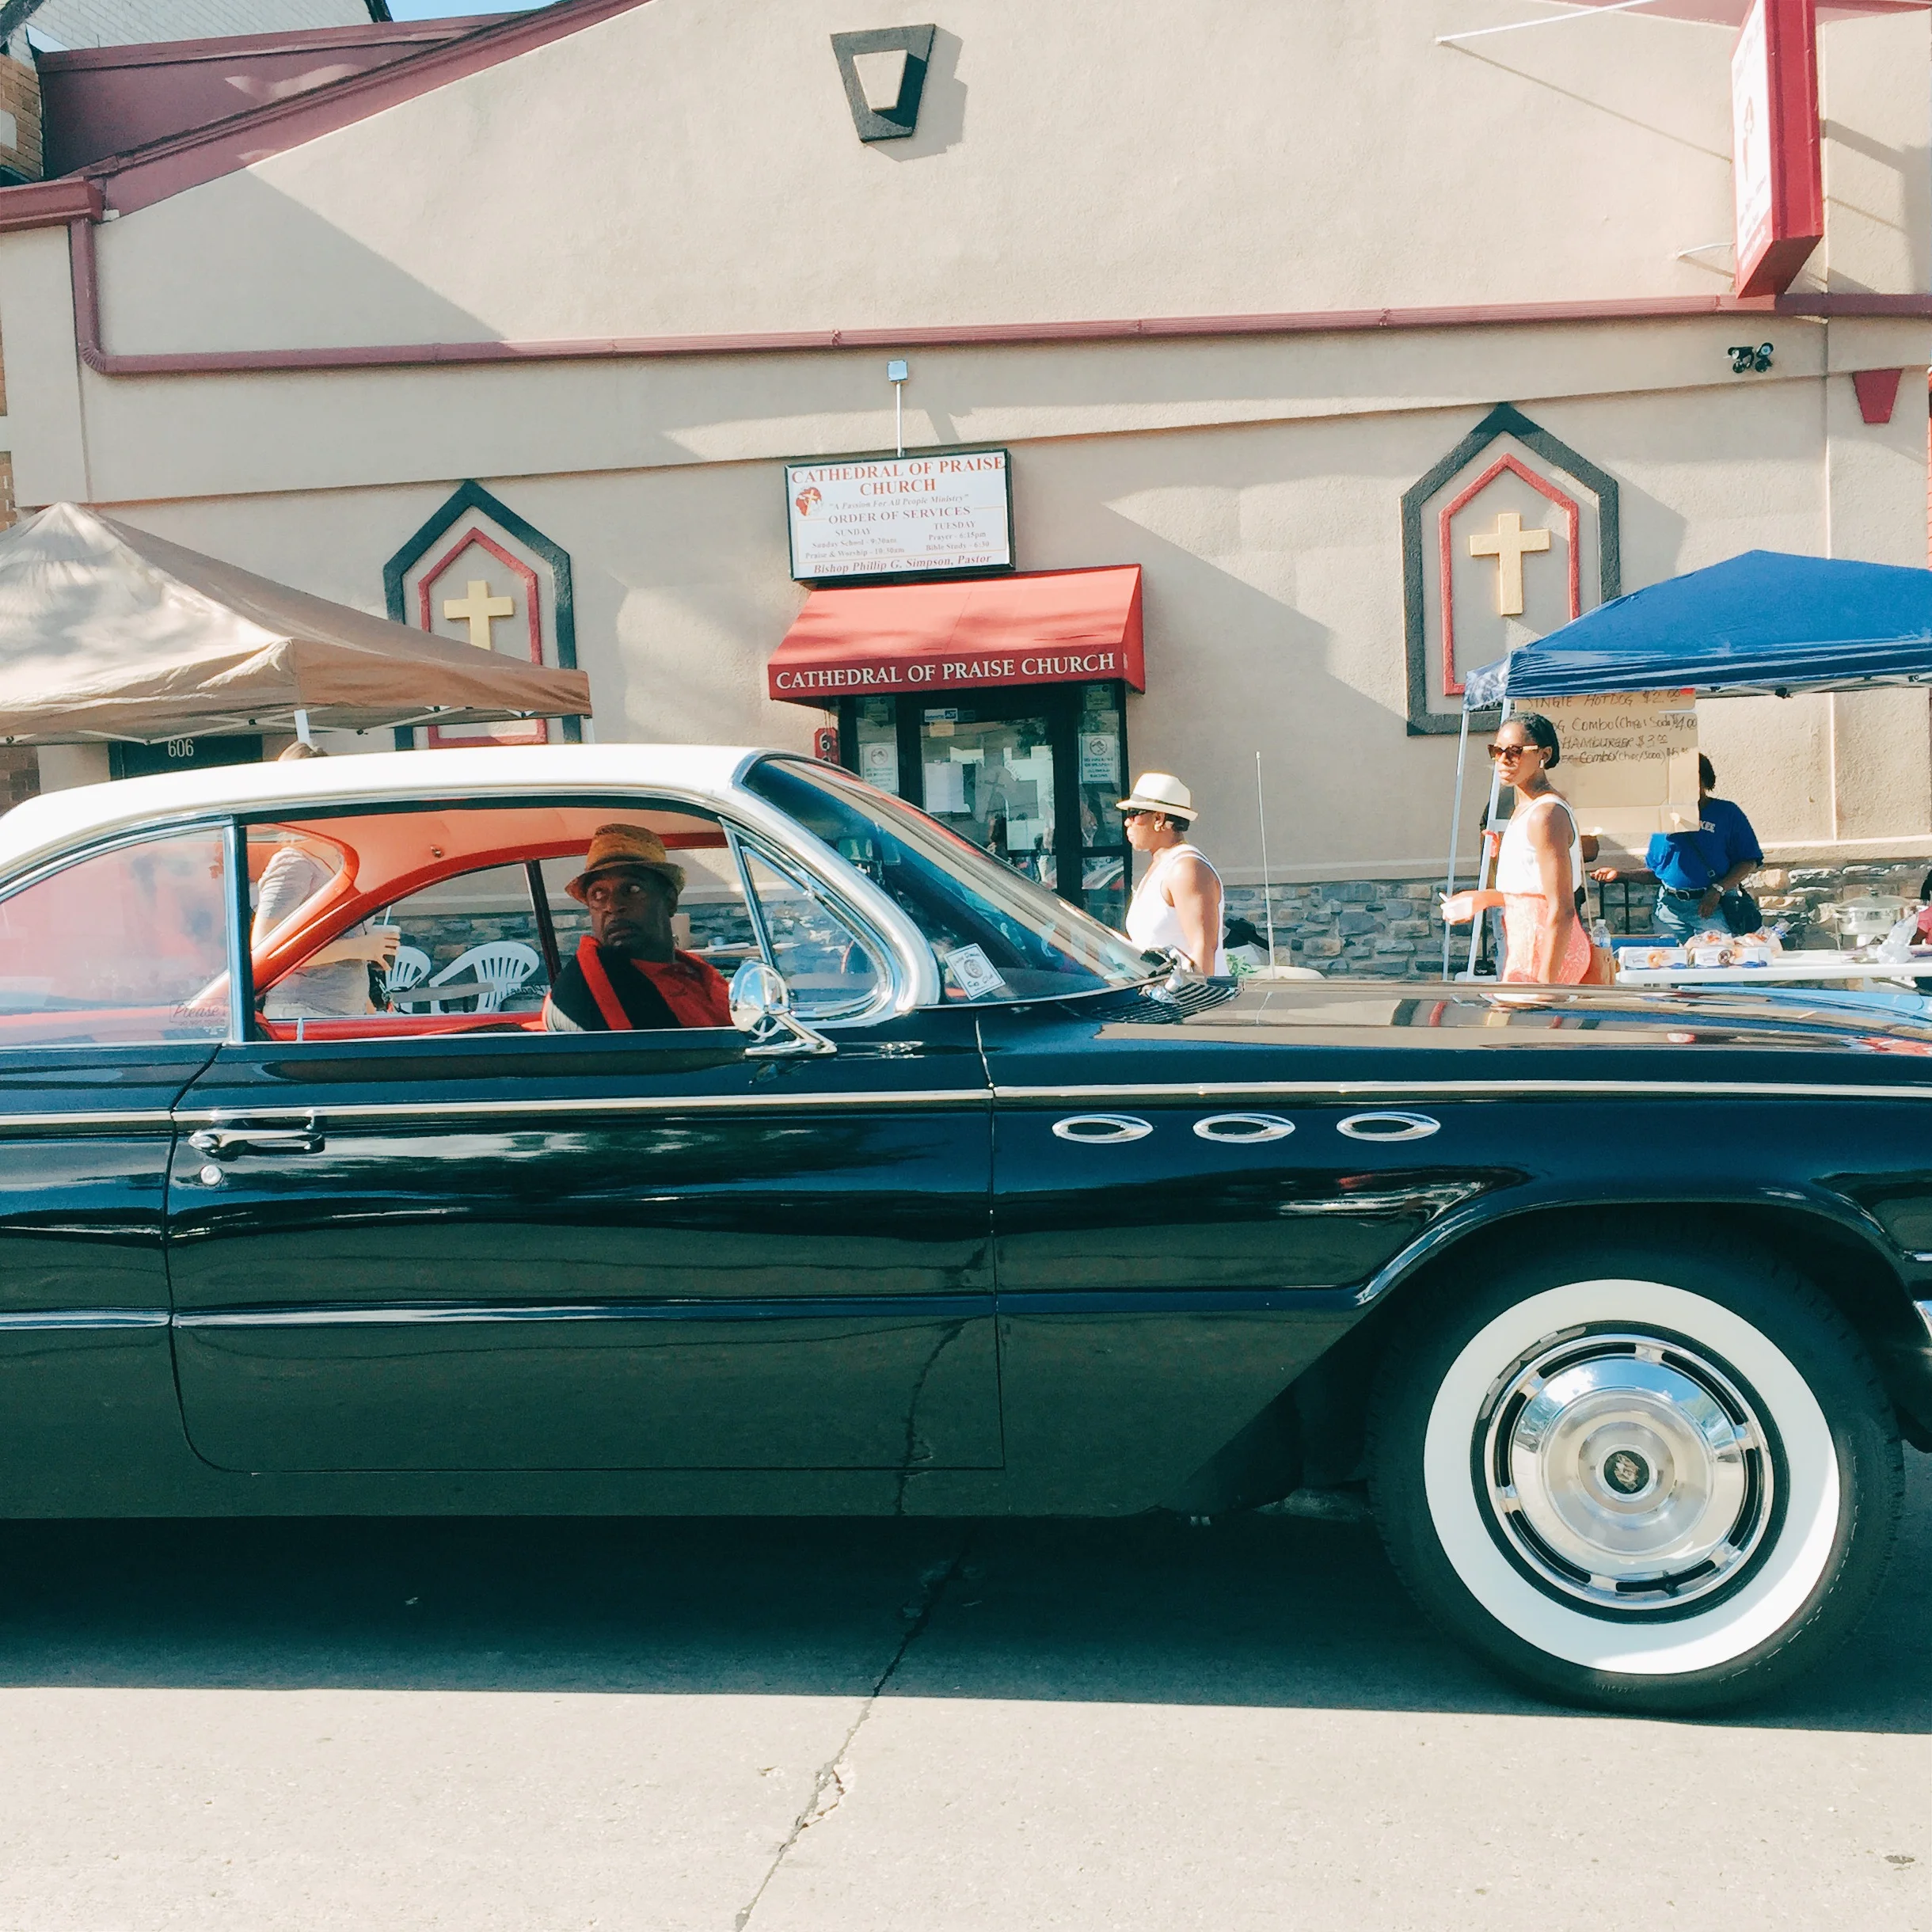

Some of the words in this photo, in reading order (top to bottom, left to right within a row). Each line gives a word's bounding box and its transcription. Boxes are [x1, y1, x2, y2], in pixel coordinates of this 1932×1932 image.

[792, 464, 903, 484] CATHEDRAL
[909, 462, 933, 476] OF
[940, 456, 1006, 473] PRAISE
[860, 478, 936, 496] CHURCH
[842, 501, 870, 511] Passion
[873, 500, 887, 508] For
[891, 498, 901, 507] All
[903, 497, 928, 508] People
[828, 514, 877, 525] ORDER
[880, 511, 899, 521] OF
[903, 506, 971, 519] SERVICES
[835, 527, 872, 537] SUNDAY
[934, 520, 976, 531] TUESDAY
[928, 534, 953, 542] Prayer
[959, 531, 987, 540] 6:15pm
[812, 541, 839, 550] Sunday
[946, 542, 967, 551] Study
[838, 549, 869, 558] Worship
[814, 564, 850, 576] Bishop
[853, 561, 888, 572] Phillip
[891, 559, 903, 569] G.
[906, 557, 954, 570] Simpson,
[957, 554, 992, 565] Pastor
[776, 666, 903, 690] CATHEDRAL
[907, 664, 935, 683] OF
[942, 659, 1015, 680] PRAISE
[1021, 652, 1116, 676] CHURCH
[1584, 694, 1633, 707] HOTDOG
[168, 738, 194, 758] 606
[173, 1002, 220, 1018] Please
